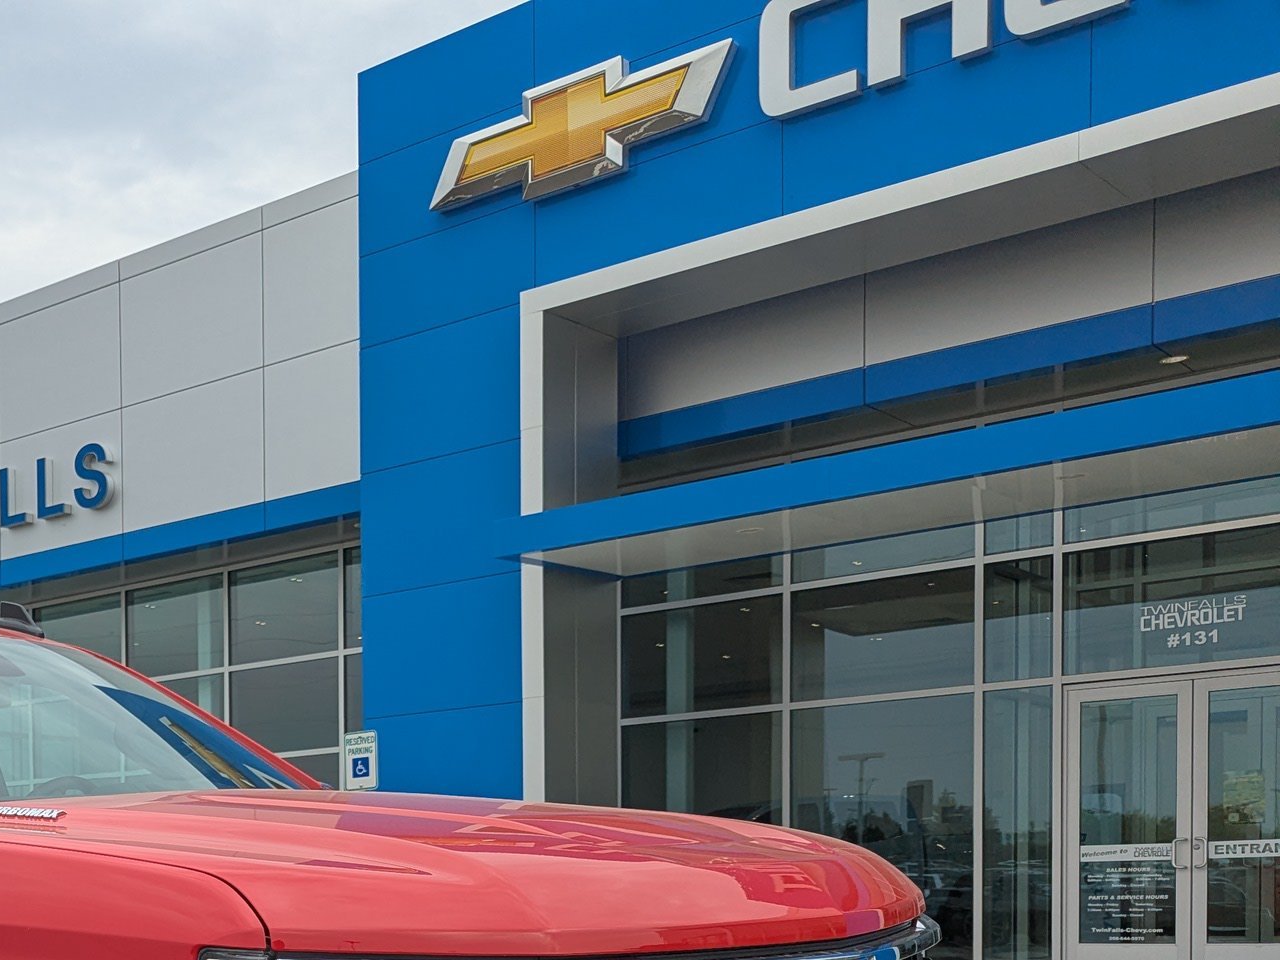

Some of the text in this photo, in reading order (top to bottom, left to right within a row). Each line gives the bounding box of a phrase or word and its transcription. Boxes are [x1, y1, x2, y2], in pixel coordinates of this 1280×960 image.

[1140, 594, 1247, 616] TWINFALLS
[1140, 604, 1247, 632] CHEVROLET
[1167, 629, 1218, 648] #131
[345, 735, 375, 746] RESERVED
[348, 746, 373, 756] PARKING
[1081, 849, 1117, 858] Welcome
